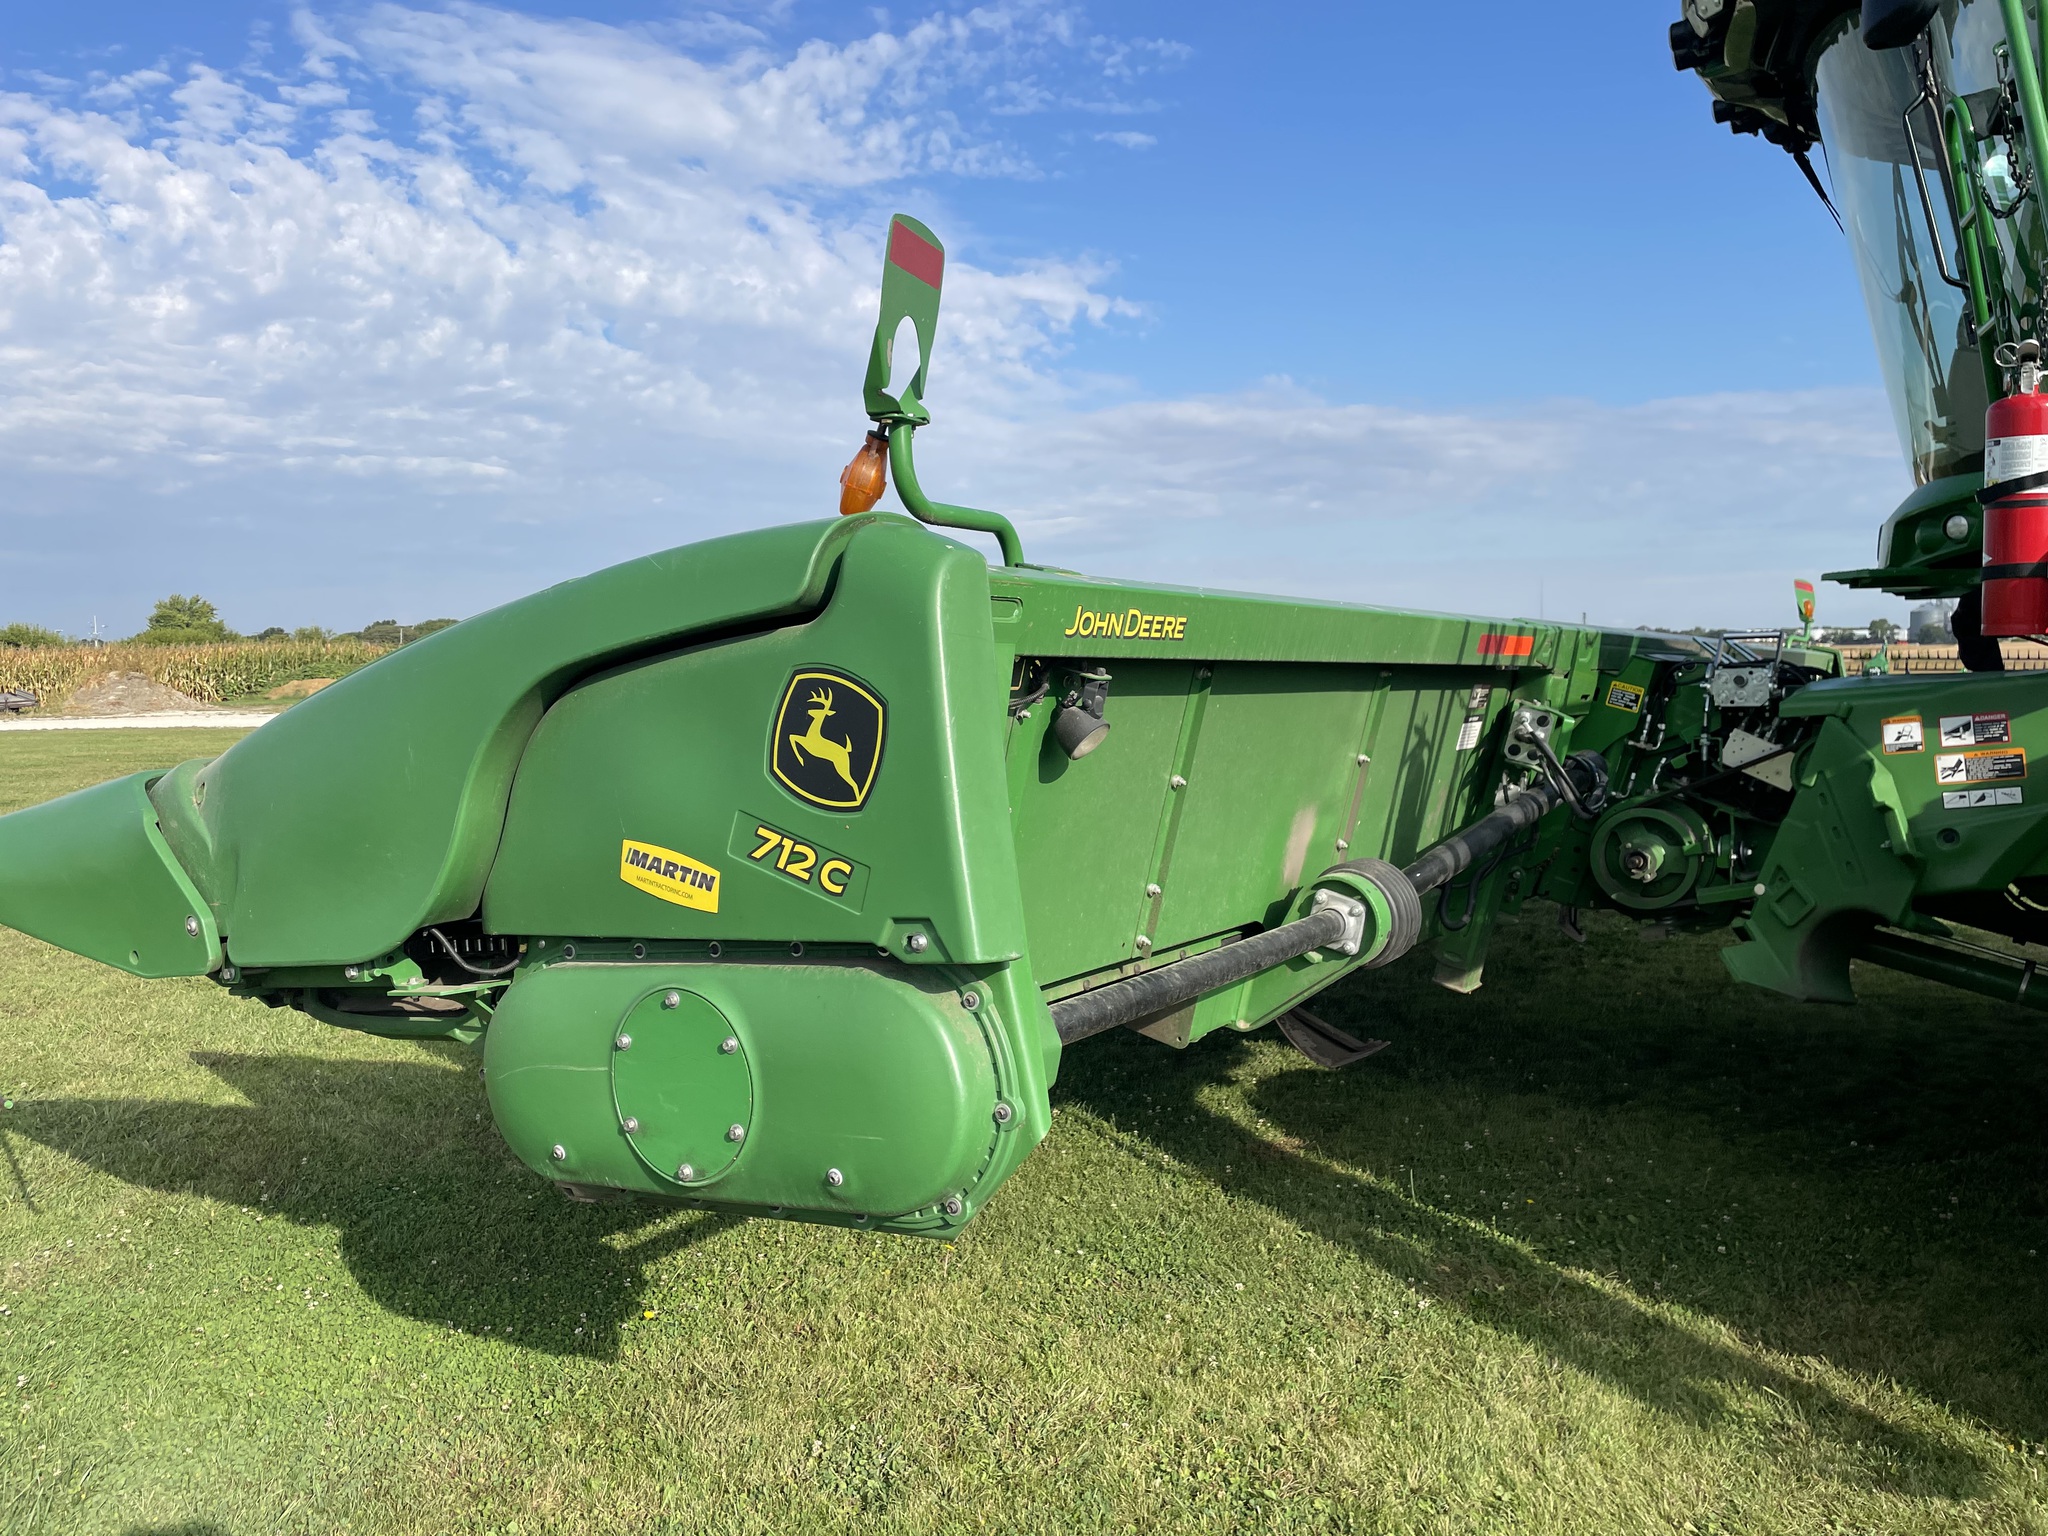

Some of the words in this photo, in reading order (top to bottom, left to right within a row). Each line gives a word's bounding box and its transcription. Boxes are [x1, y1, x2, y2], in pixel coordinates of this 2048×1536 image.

[1065, 605, 1124, 638] JOHN
[1123, 608, 1187, 640] DEERE
[1618, 683, 1642, 694] CAUTION
[628, 848, 716, 893] MARTIN
[636, 875, 694, 900] MARTINTRACTORINC.COM
